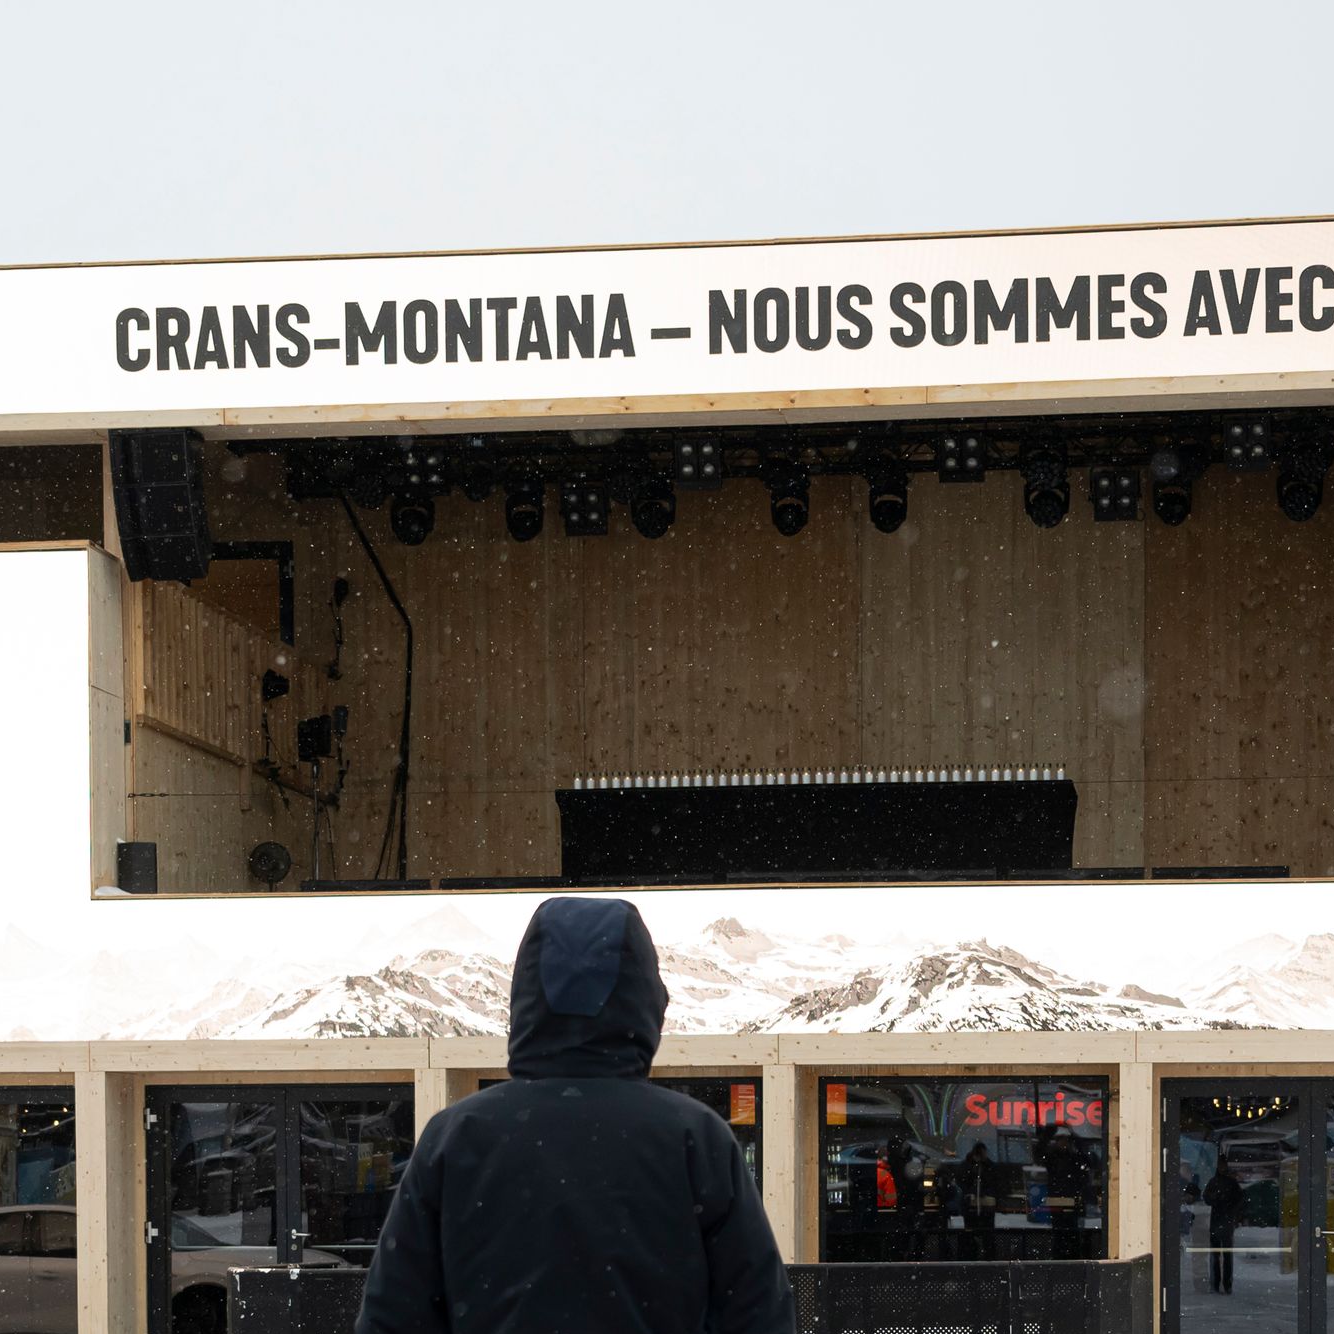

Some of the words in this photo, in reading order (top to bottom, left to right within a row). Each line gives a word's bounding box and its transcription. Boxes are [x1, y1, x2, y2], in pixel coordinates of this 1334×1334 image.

[115, 294, 636, 372] CRANS-MONTANA
[708, 284, 873, 355] NOUS
[889, 271, 1168, 348] SOMMES
[965, 1092, 1102, 1126] Sunrise
